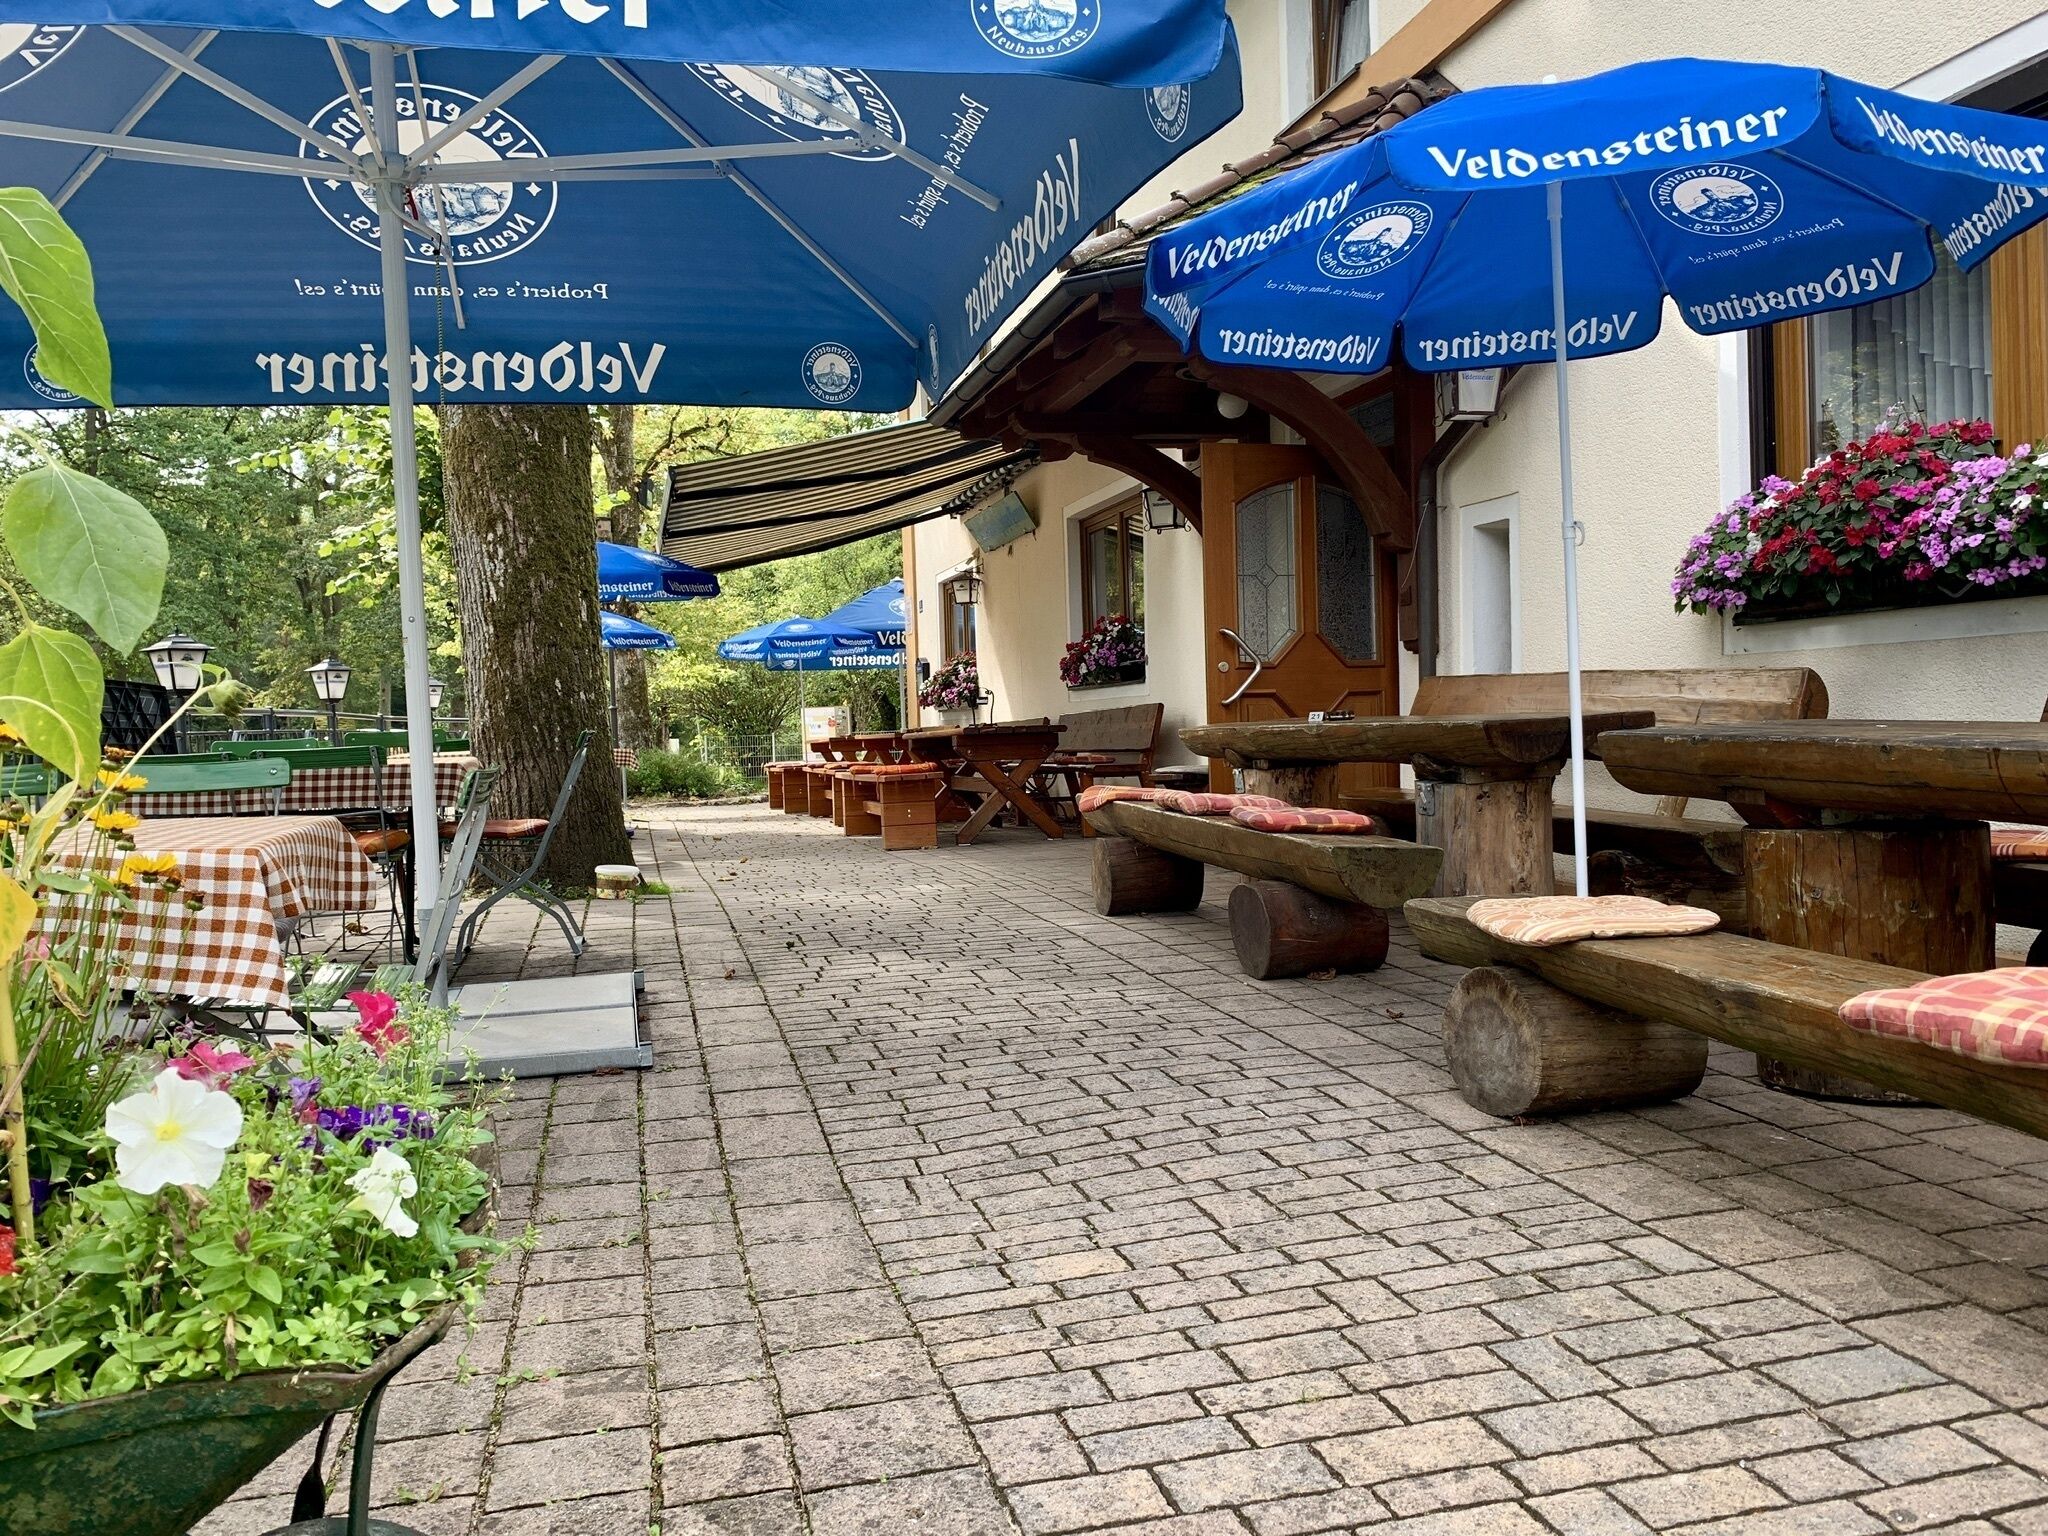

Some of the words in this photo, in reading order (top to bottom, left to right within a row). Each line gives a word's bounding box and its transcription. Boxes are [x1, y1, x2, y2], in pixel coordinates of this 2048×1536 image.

[987, 25, 1088, 55] Neuhaus/Peg.
[1427, 106, 1789, 179] Veldensteiner
[1168, 180, 1358, 280] Veldensteiner
[598, 580, 654, 593] ensteiner
[611, 636, 660, 646] Veldensteiner
[774, 638, 827, 648] Veldensteiner
